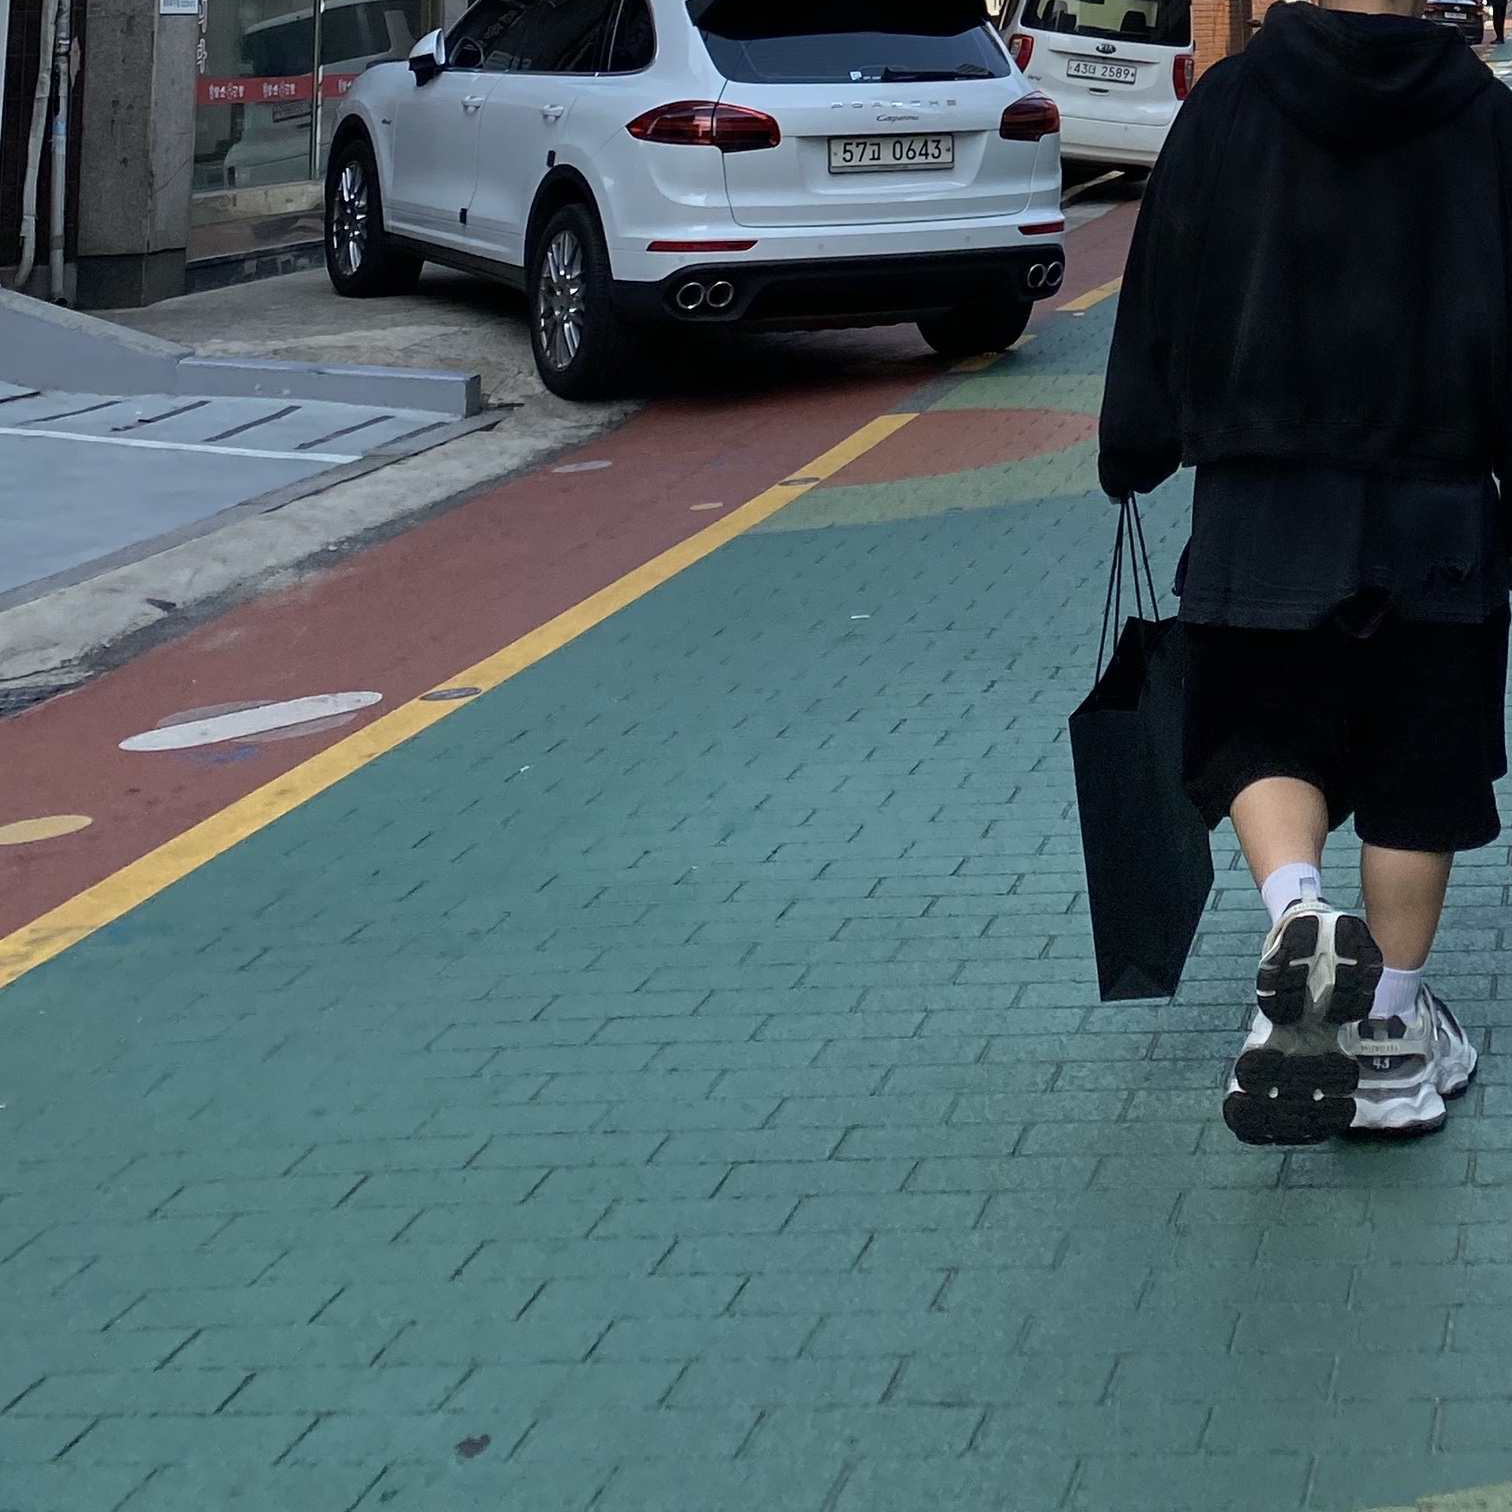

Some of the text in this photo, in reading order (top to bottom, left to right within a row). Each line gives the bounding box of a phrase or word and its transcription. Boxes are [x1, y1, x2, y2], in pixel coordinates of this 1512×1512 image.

[1101, 66, 1130, 80] 2589
[842, 139, 942, 163] 57고 0643
[1373, 1057, 1390, 1070] 43
